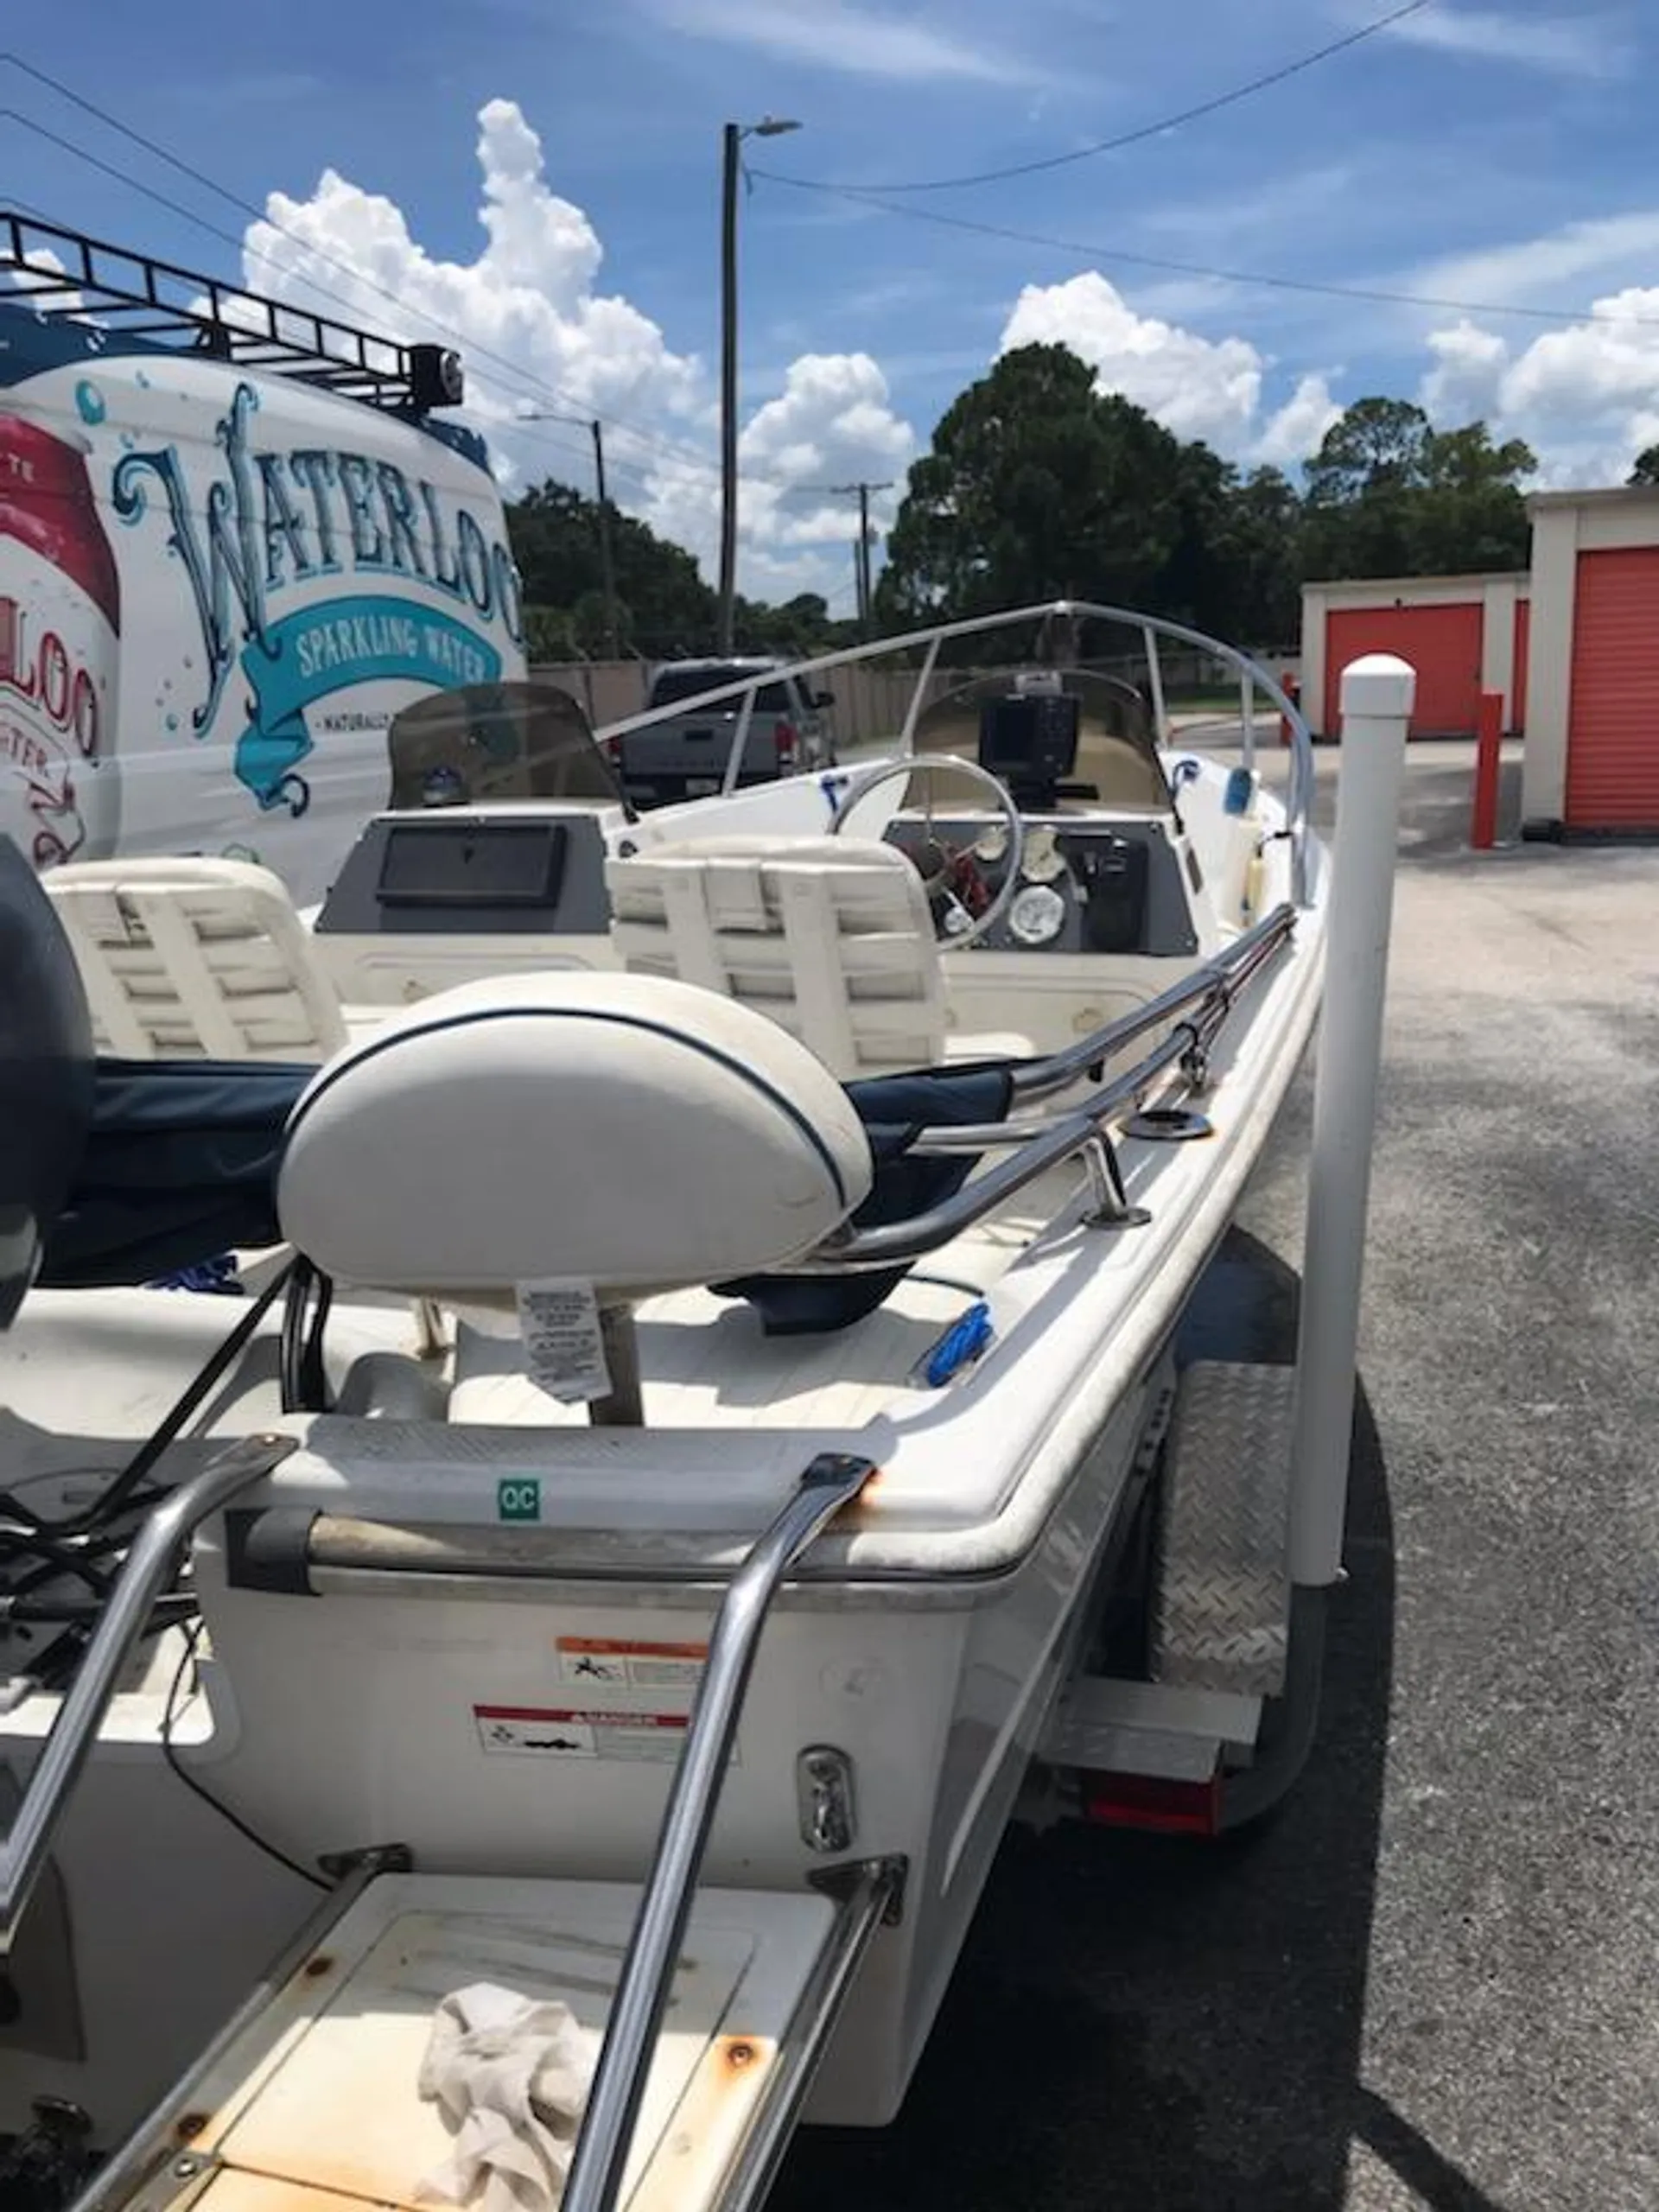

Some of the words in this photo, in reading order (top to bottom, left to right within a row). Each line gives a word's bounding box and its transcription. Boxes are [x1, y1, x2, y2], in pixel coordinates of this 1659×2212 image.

[112, 382, 523, 740] WATERLOO
[296, 614, 418, 678] SPARKLING
[423, 625, 486, 685] WATER
